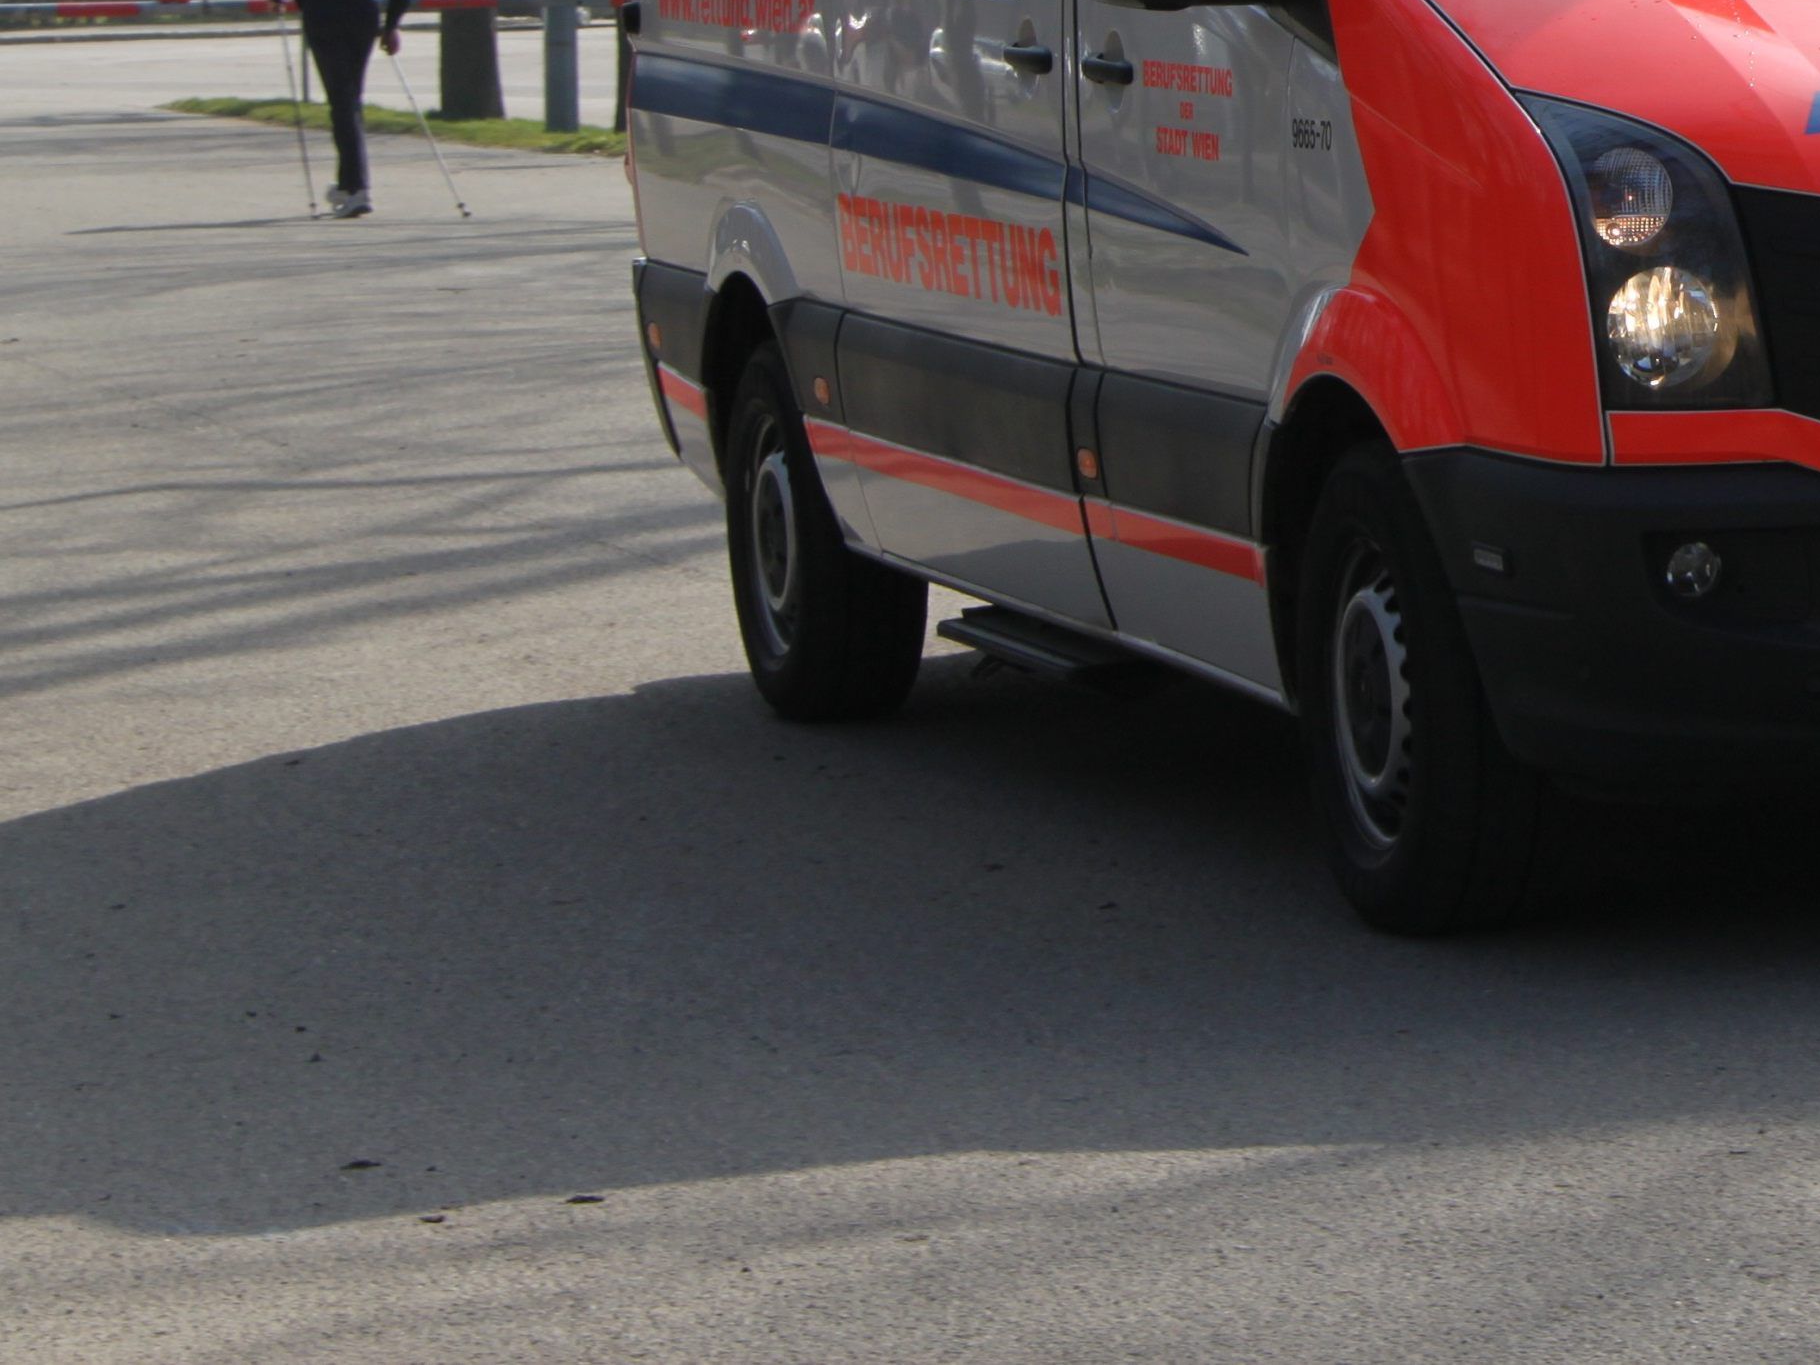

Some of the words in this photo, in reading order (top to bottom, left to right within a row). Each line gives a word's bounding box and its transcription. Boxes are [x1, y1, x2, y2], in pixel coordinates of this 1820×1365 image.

[1142, 60, 1233, 98] BERUFSRETTUNG
[1179, 101, 1194, 120] DER
[1156, 126, 1188, 156] STADT
[1192, 131, 1220, 161] WIEN
[1292, 118, 1332, 151] 9665-70
[837, 193, 1062, 316] BERUFSRETTUNG
